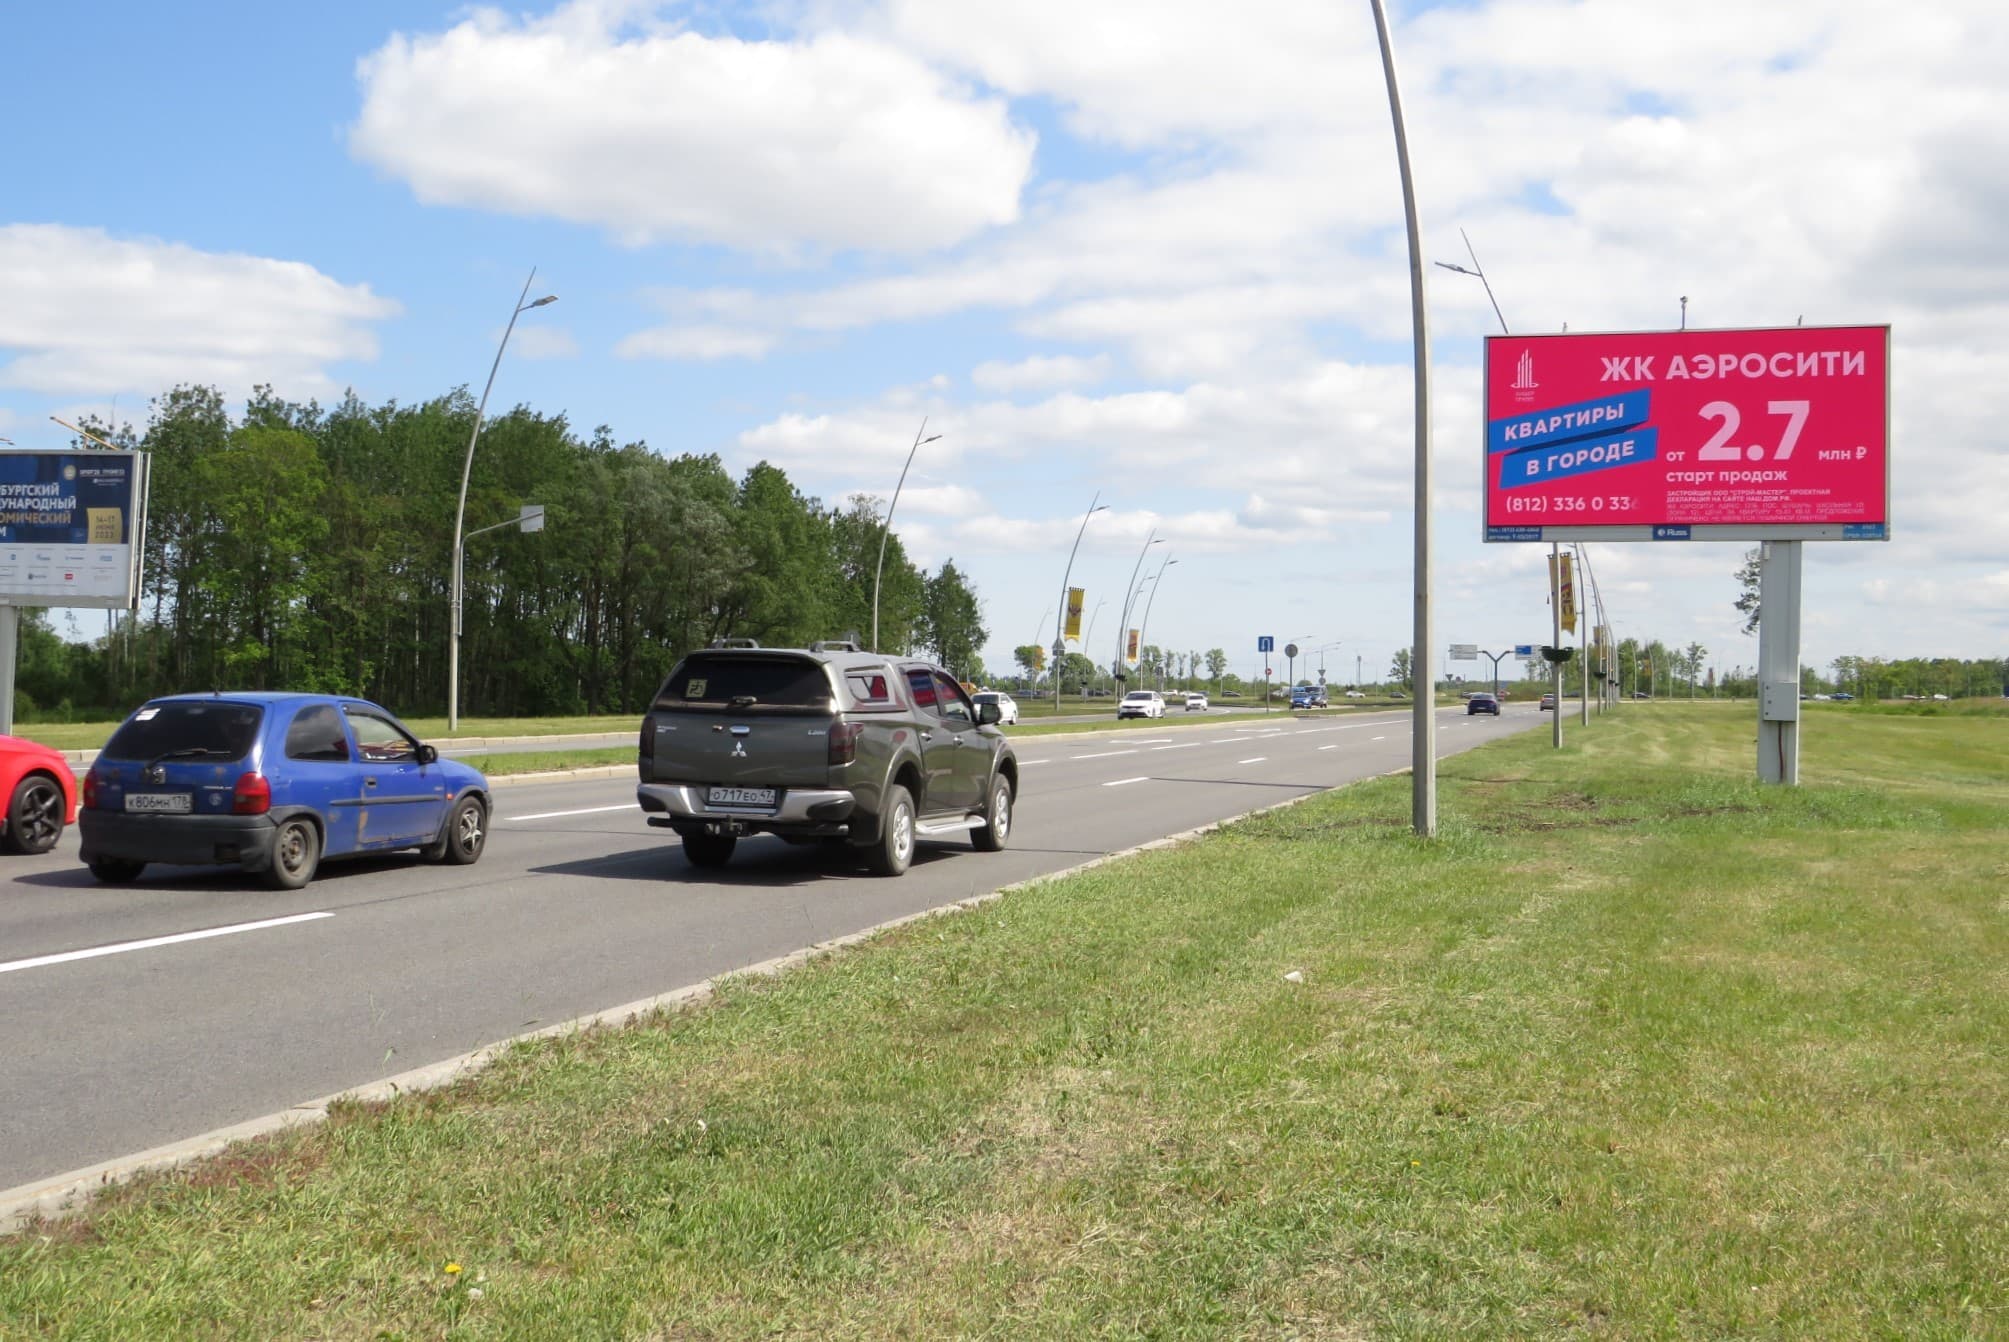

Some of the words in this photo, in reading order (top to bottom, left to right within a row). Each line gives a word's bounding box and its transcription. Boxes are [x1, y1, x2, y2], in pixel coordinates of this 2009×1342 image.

[1600, 356, 1655, 381] ЖК
[1665, 351, 1865, 380] АЭРОСИТИ
[1504, 403, 1625, 441] КВАРТИРЫ
[1665, 450, 1685, 462] от
[1698, 400, 1810, 461] 2.7
[1818, 449, 1851, 460] млн
[1526, 459, 1540, 475] В
[1547, 440, 1635, 472] ГОРОДЕ
[1665, 470, 1714, 484] старт
[1719, 470, 1788, 484] продаж
[0, 482, 60, 496] БУРГСКИЙ
[0, 495, 77, 512] УНАРОДНЫЙ
[1506, 496, 1547, 512] (812)
[1553, 497, 1586, 511] 336
[1591, 496, 1604, 511] 0
